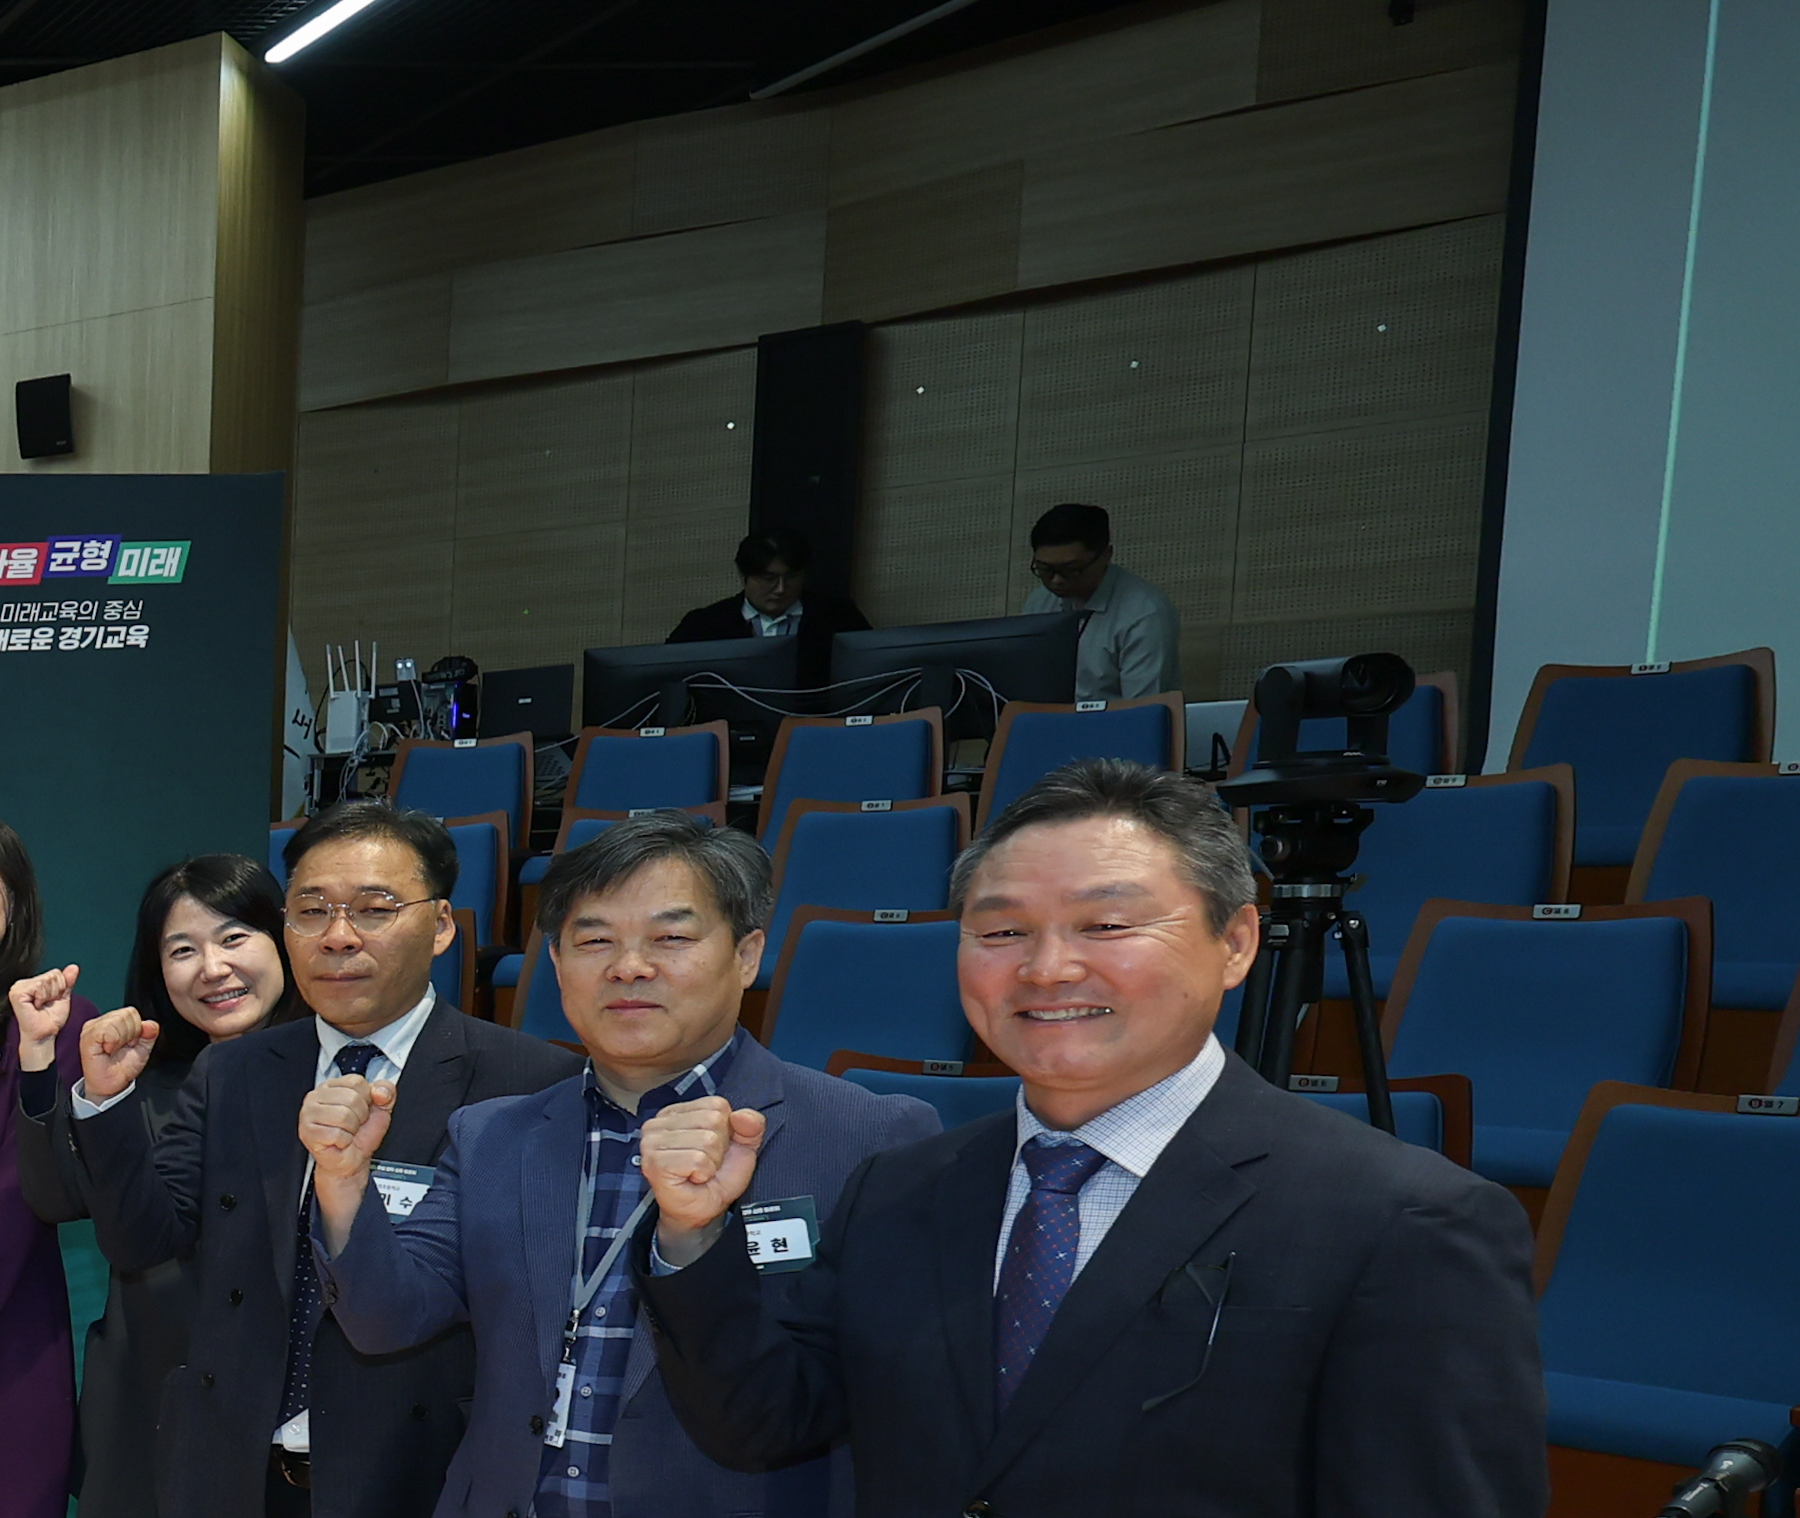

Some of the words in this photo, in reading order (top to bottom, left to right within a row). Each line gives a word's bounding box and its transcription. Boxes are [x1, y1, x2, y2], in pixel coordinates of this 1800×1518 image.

[48, 540, 113, 572] 균형
[117, 546, 183, 578] 미래
[0, 600, 99, 623] 미래교육의
[103, 599, 144, 620] 중심
[57, 624, 151, 650] 경기교육
